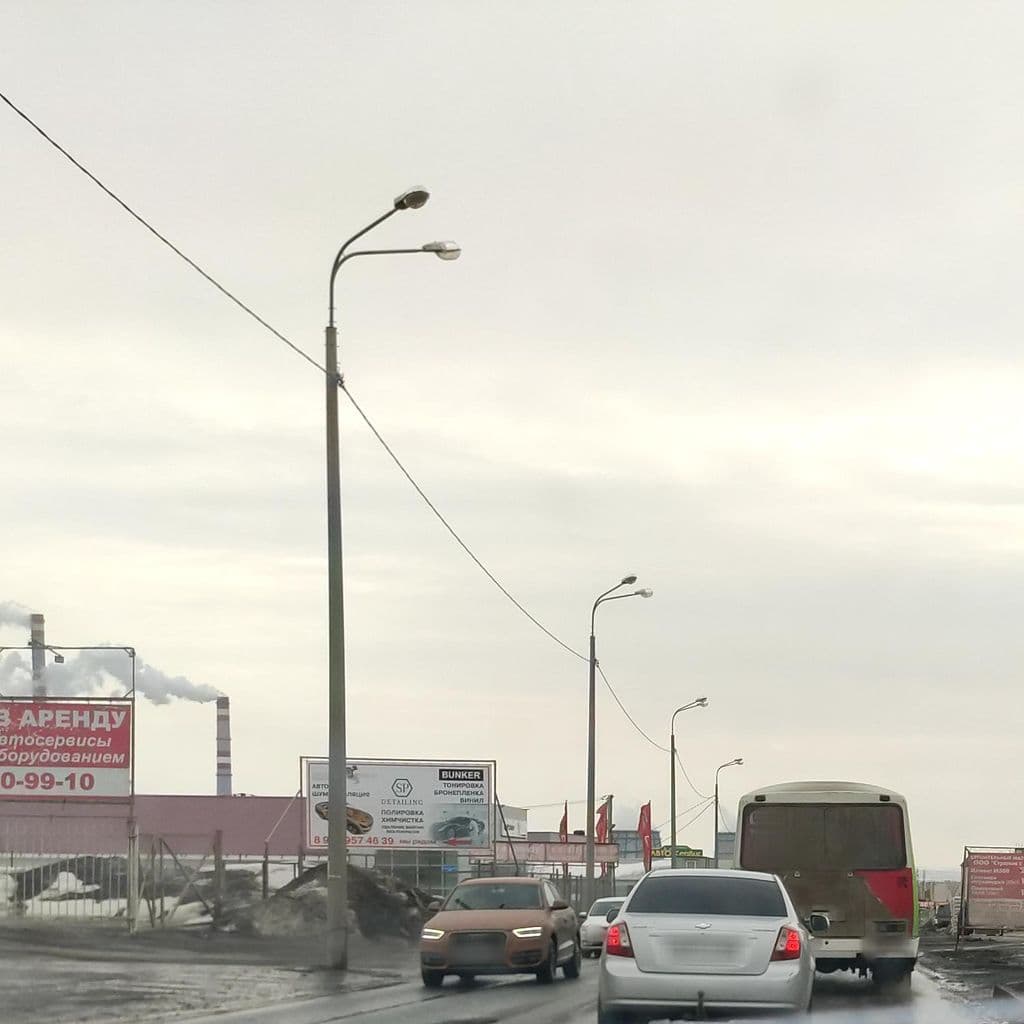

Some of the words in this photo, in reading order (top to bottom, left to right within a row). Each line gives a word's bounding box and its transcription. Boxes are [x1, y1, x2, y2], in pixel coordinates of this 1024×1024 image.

[20, 709, 127, 731] АРЕНДУ
[1, 772, 95, 790] 0-99-10
[441, 770, 481, 779] BUNKER
[395, 782, 410, 793] SP
